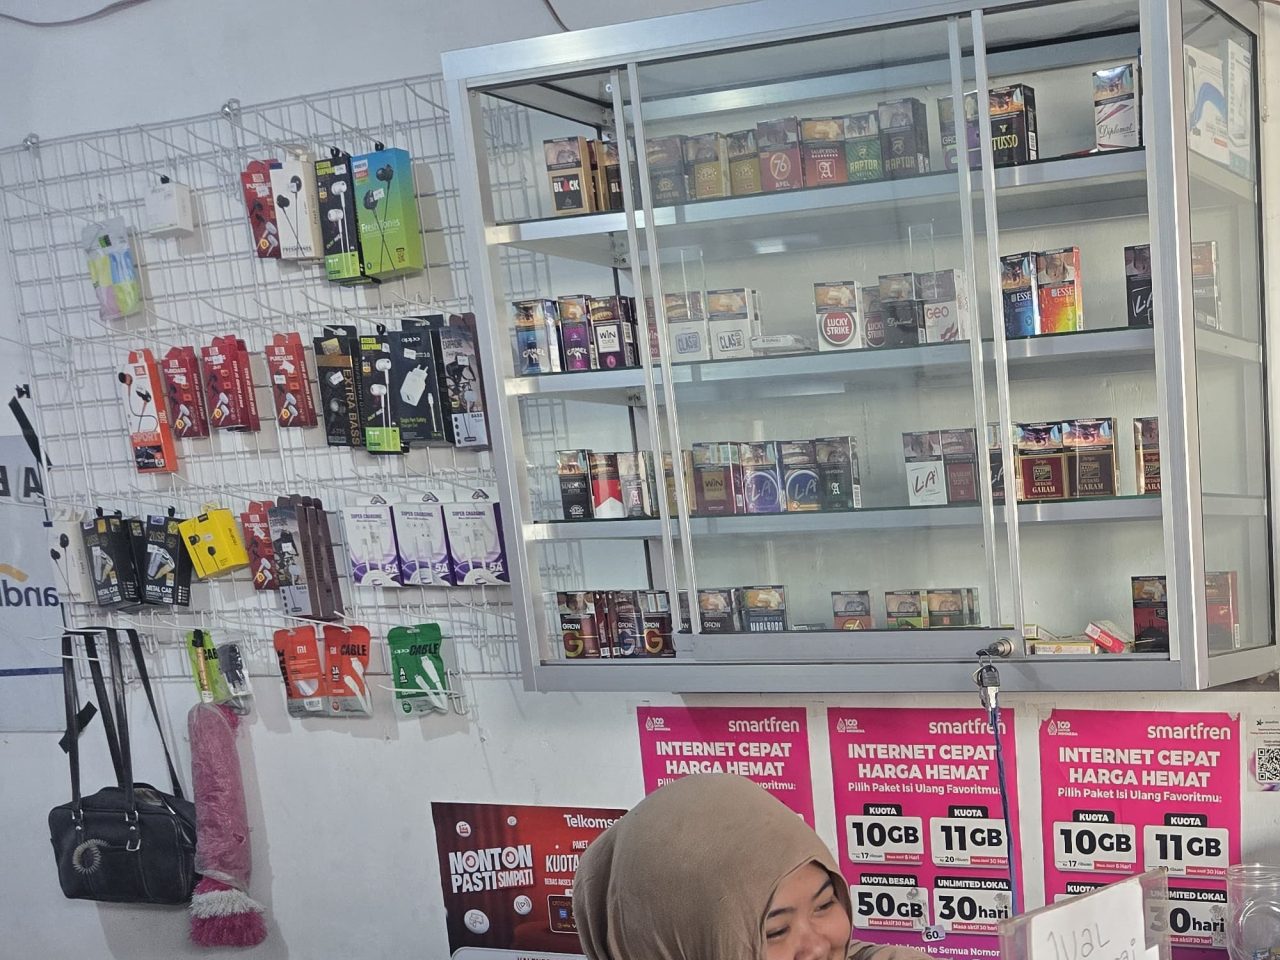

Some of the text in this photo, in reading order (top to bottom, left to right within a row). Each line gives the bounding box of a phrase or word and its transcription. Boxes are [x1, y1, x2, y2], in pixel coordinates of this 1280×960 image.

[850, 160, 878, 172] RAPTOR
[886, 156, 915, 171] RAPTOR
[1016, 291, 1031, 301] ESSE
[1056, 287, 1073, 297] ESSE
[827, 318, 848, 327] LUCKY
[827, 326, 850, 335] STRIKE
[343, 369, 360, 445] EXTRA BASS
[705, 478, 723, 487] WIN
[1079, 483, 1104, 491] GARAM
[340, 644, 367, 656] CABLE
[410, 643, 440, 656] CABLE
[729, 717, 799, 732] smartfren
[929, 718, 1006, 734] smartfren
[1148, 723, 1230, 740] smartfren
[656, 742, 791, 757] INTERNET CEPAT
[848, 744, 997, 760] INTERNET CEPAT
[1059, 748, 1220, 766] INTERNET CEPAT
[666, 761, 784, 776] HARGA HEMAT
[859, 764, 989, 780] HARGA HEMAT
[1070, 768, 1210, 787] HARGA HEMAT
[848, 782, 870, 792] Pilih
[872, 783, 900, 793] Paket
[902, 783, 913, 793] Isi
[916, 784, 944, 795] Ulang
[1058, 788, 1081, 797] Pilih
[1084, 789, 1114, 798] Paket
[1116, 790, 1127, 798] Isi
[1130, 791, 1161, 801] Ulang
[869, 807, 982, 817] KUOTA KUOTA
[1079, 814, 1201, 825] KUOTA KUOTA
[449, 845, 533, 875] NONTON
[546, 854, 580, 873] KUOTA
[451, 869, 534, 894] PASTI SIMPATI
[861, 876, 1008, 889] KUOTA BESAR UNLIMITED LOKAL
[1197, 893, 1225, 901] LOKAL
[939, 946, 968, 955] Semua
[971, 947, 1000, 956] Nomor
